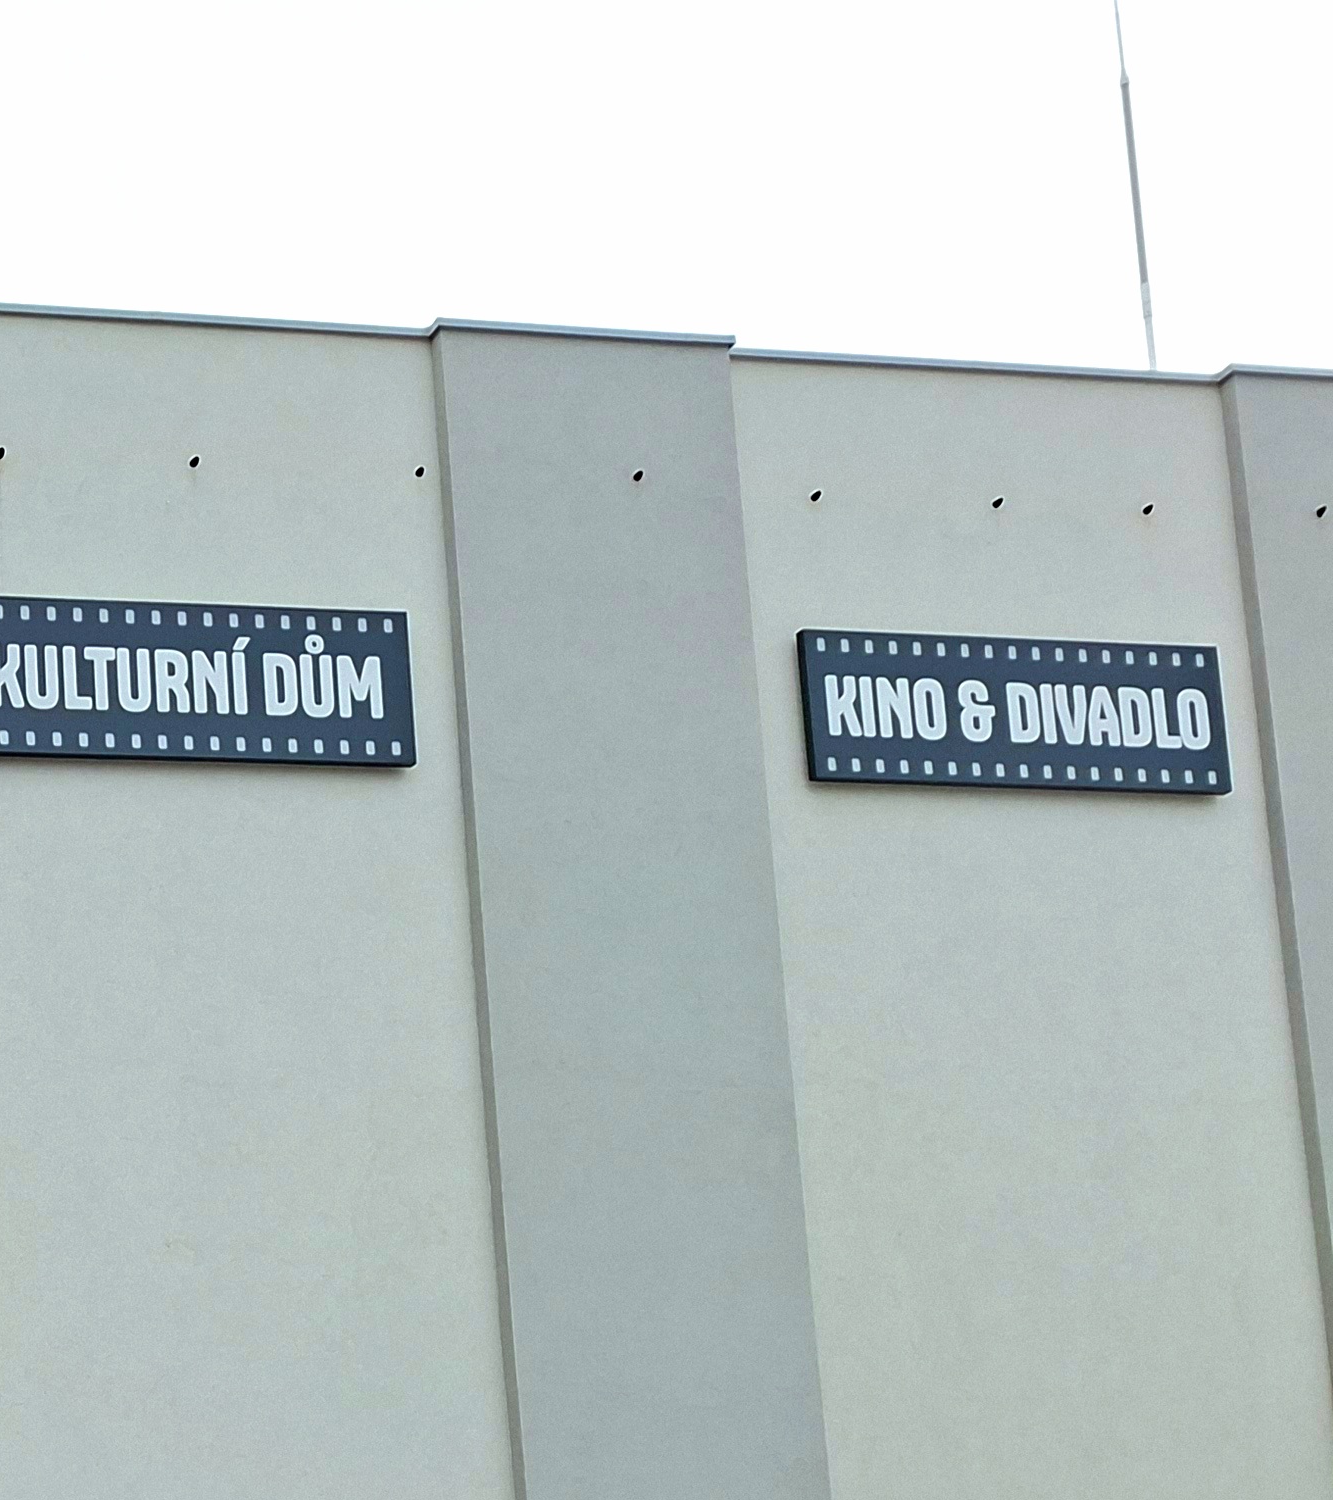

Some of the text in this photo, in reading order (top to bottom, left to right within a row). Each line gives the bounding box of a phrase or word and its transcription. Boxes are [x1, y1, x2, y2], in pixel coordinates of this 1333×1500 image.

[262, 633, 384, 720] DŮM
[824, 674, 1212, 751] KINO & DIVADLO
